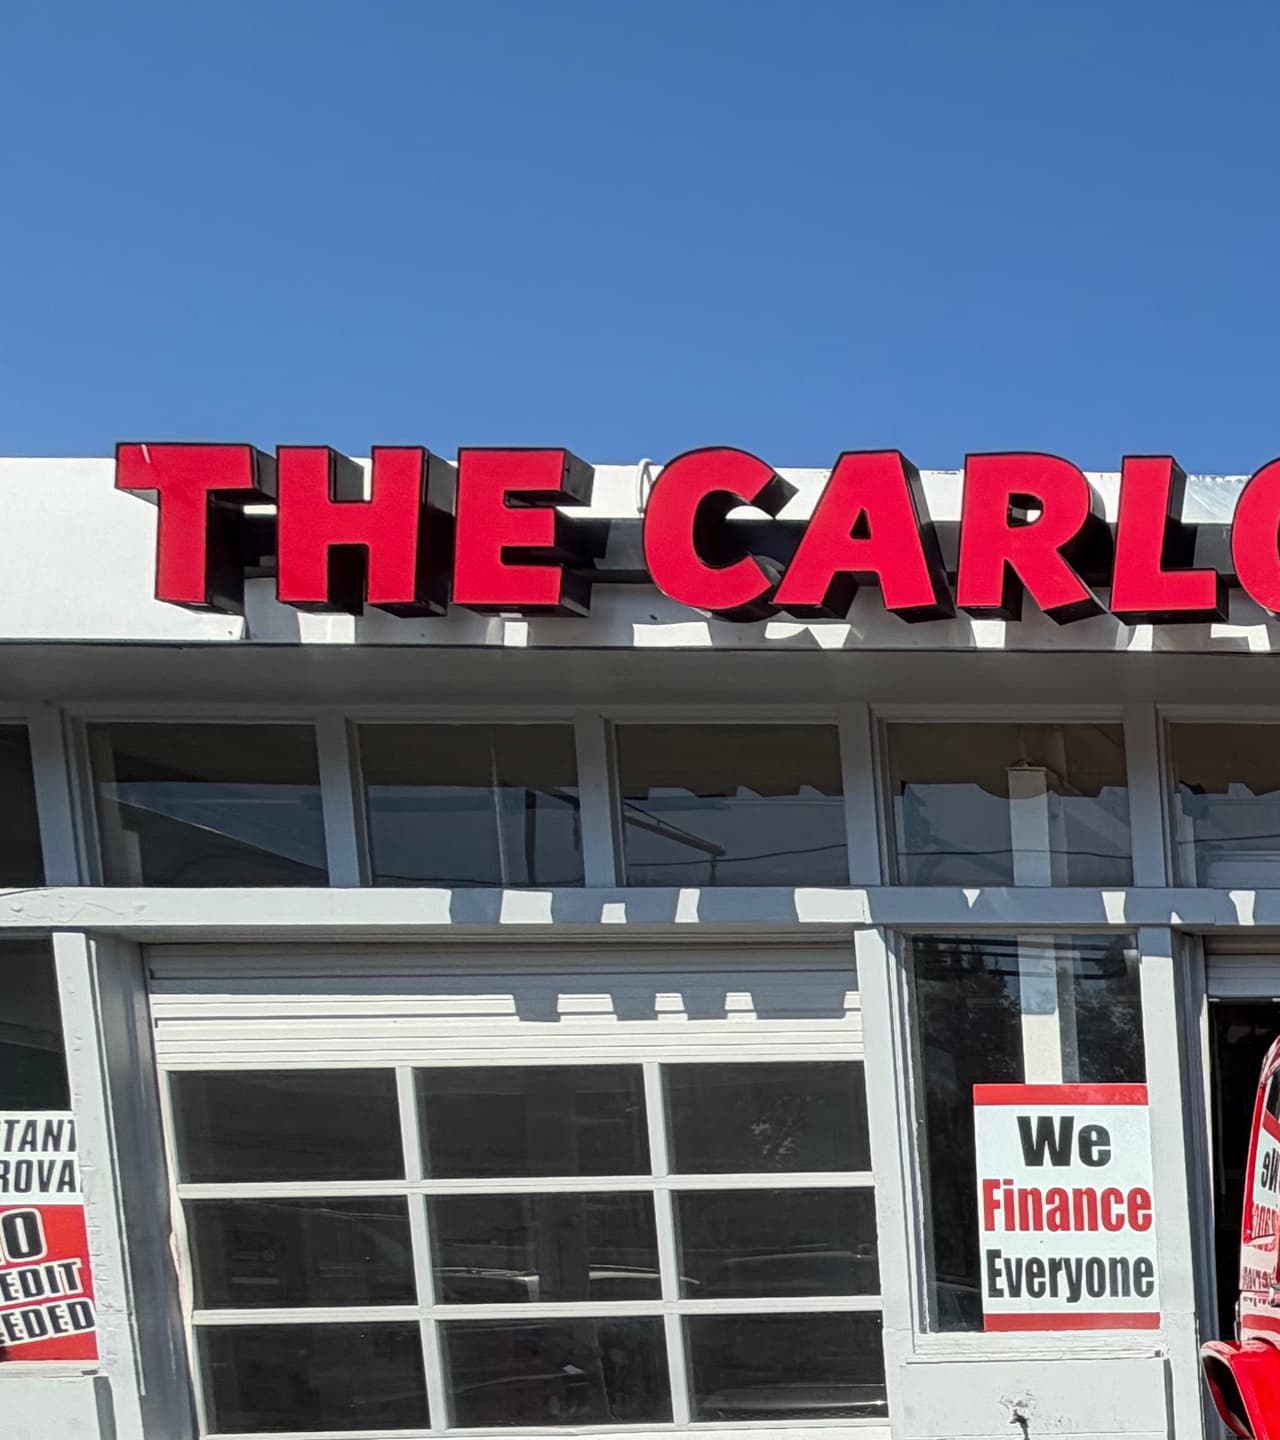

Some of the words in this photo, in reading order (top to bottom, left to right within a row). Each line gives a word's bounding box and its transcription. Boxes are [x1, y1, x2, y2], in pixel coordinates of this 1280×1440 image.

[115, 443, 572, 612] THE
[0, 1119, 77, 1153] TANT
[1017, 1116, 1112, 1168] We
[0, 1158, 84, 1194] ROVA
[982, 1178, 1153, 1232] Finance
[0, 1209, 45, 1261] O
[986, 1248, 1155, 1303] Everyone
[0, 1299, 96, 1345] EDED
